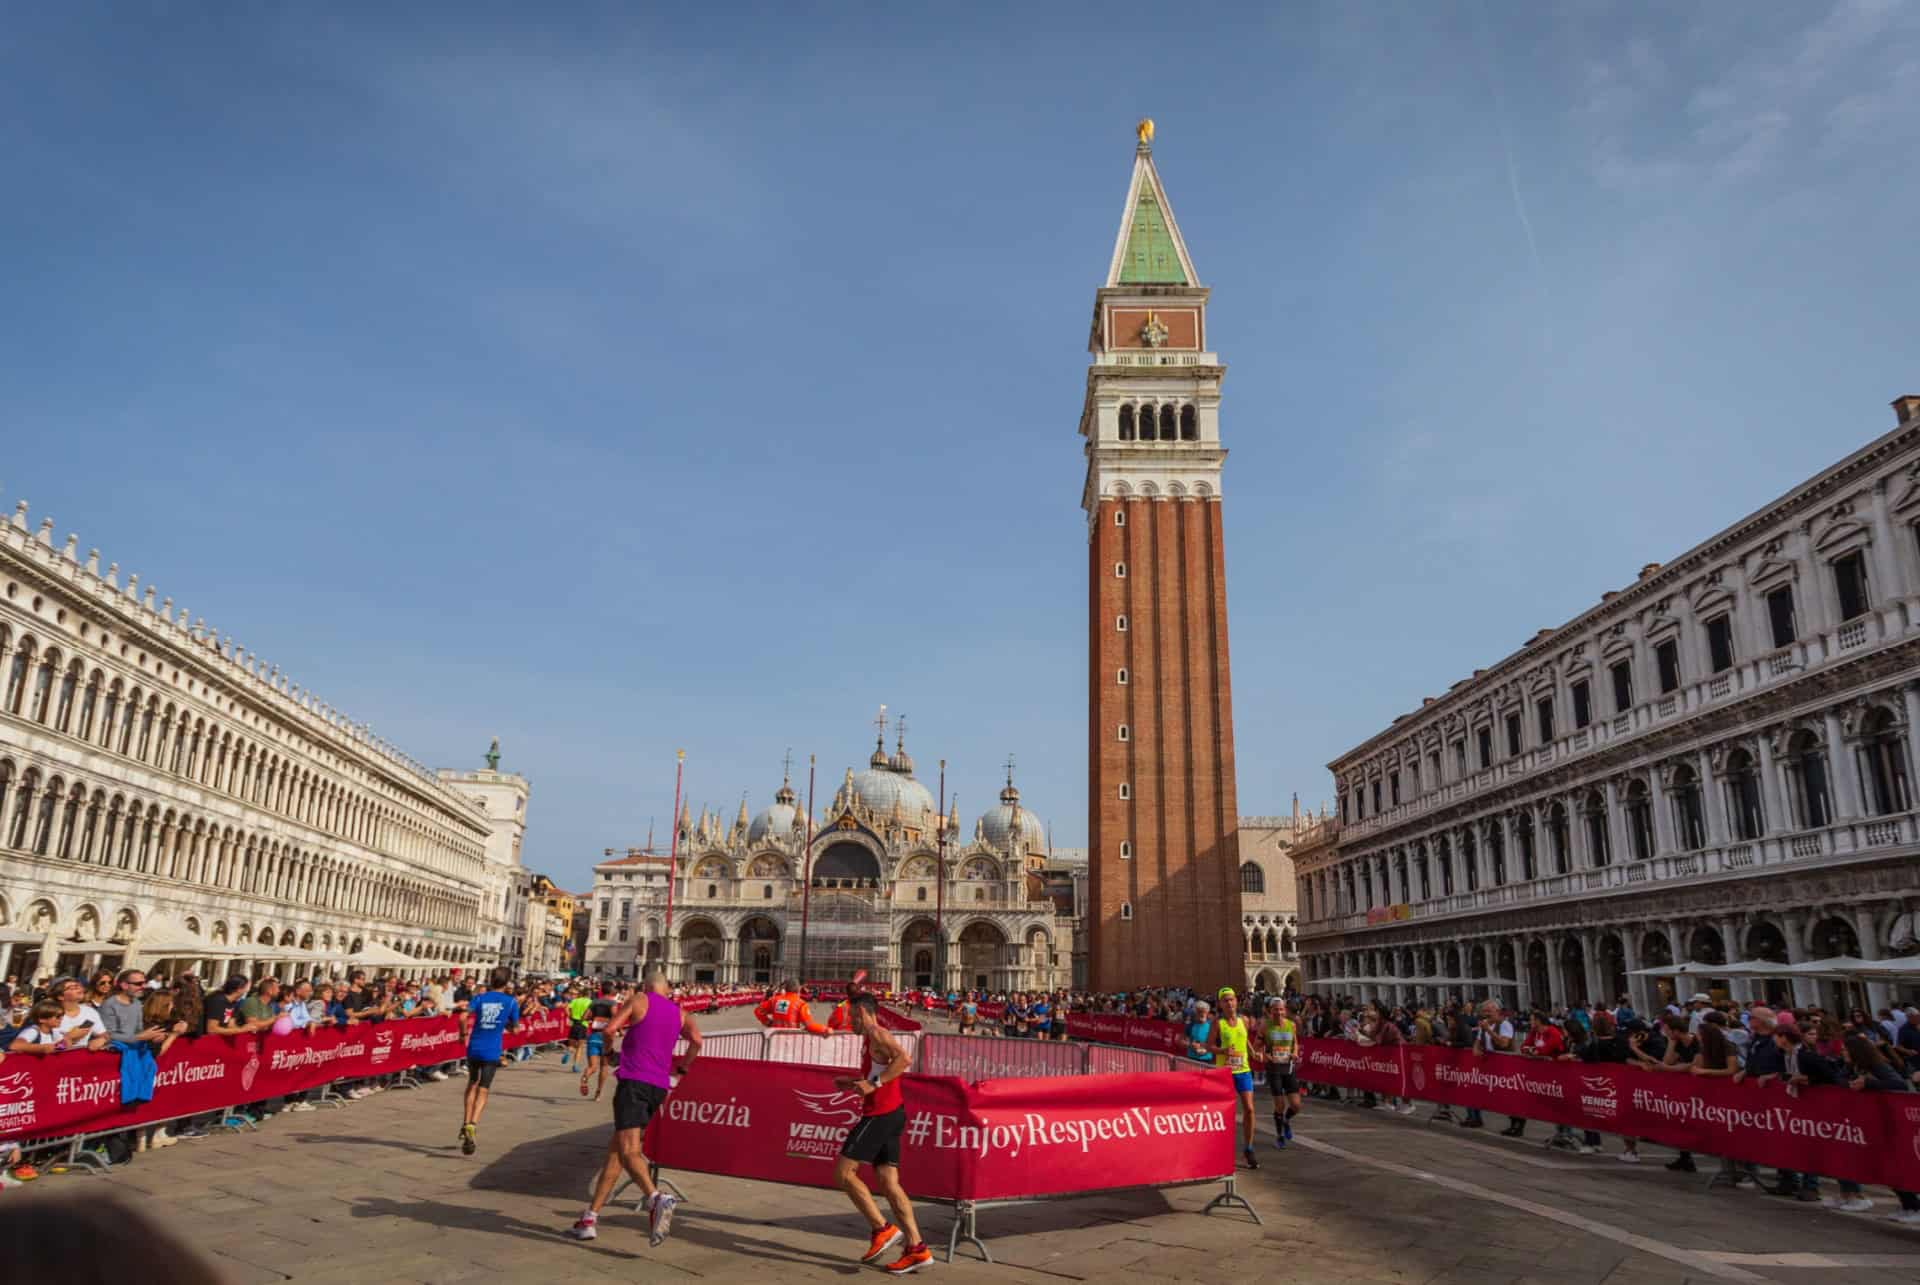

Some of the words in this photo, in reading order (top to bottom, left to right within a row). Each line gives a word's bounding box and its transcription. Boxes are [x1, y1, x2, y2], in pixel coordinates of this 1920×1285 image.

[1434, 1063, 1565, 1098] #EnjoyRespectVenezia
[0, 1100, 35, 1117] ENICE
[659, 1096, 751, 1128] enezia
[1631, 1086, 1867, 1146] #EnjoyRespectVenezia
[789, 1122, 849, 1142] VENIC
[908, 1104, 1226, 1158] #EnjoyRespectVenezia
[786, 1139, 843, 1156] MARATH
